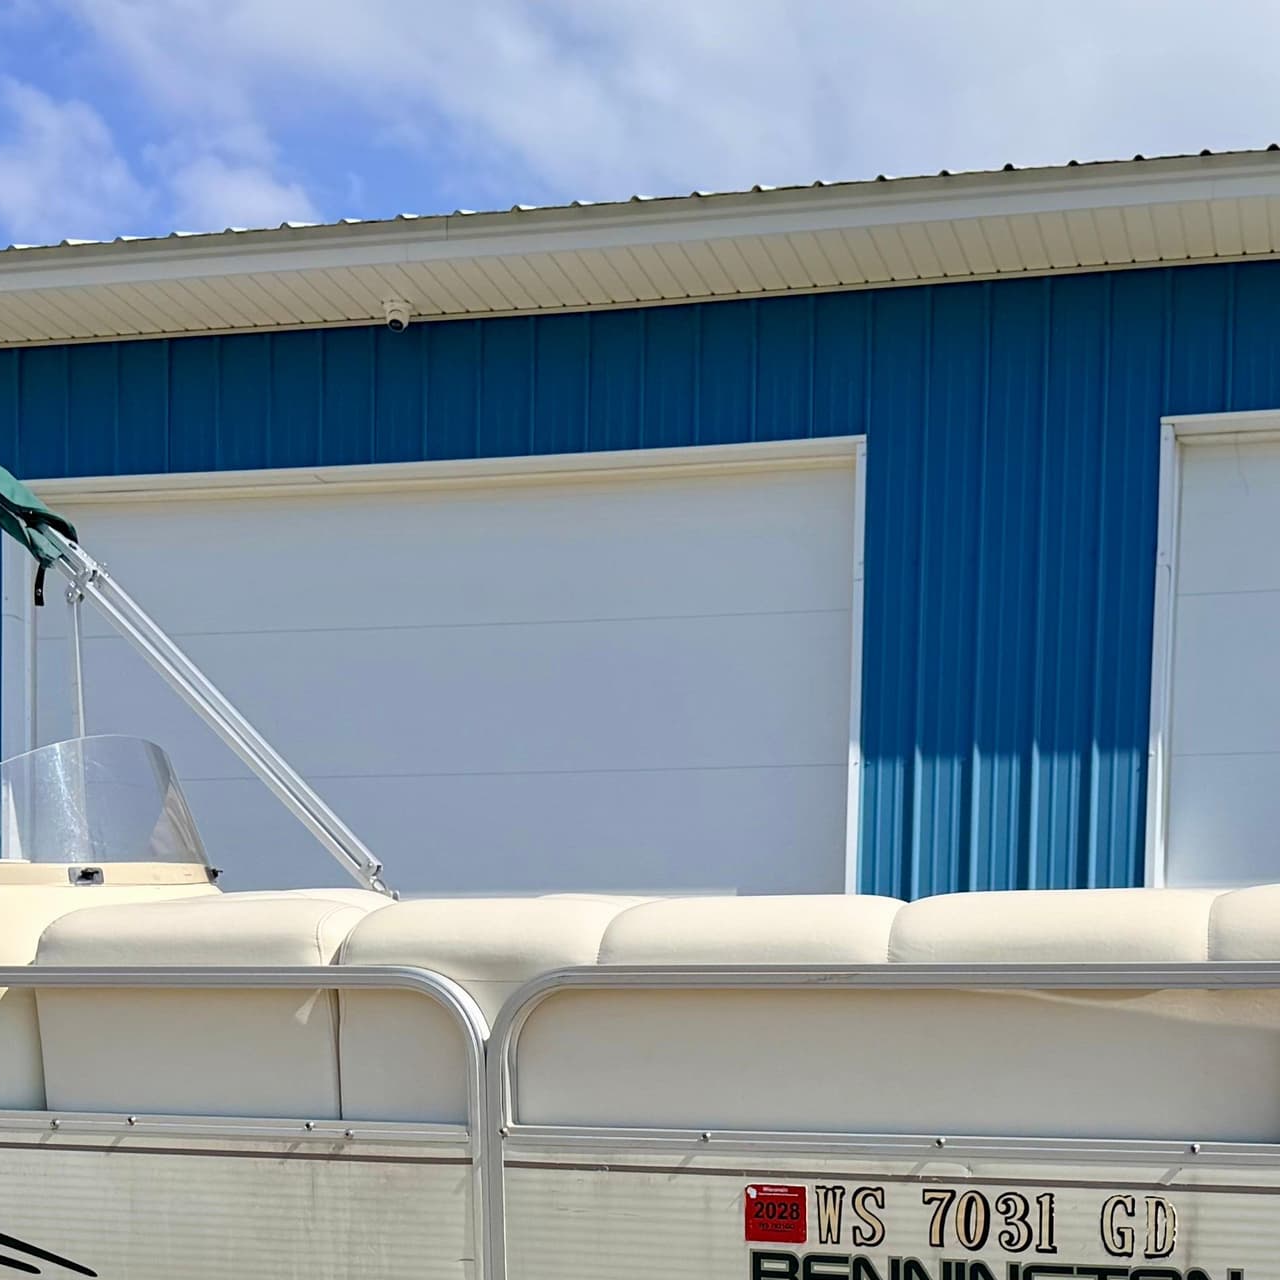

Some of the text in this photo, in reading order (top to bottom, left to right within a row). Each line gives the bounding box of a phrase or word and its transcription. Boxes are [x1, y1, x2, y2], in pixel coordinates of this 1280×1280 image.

[754, 1201, 800, 1220] 2028
[815, 1185, 1178, 1259] WS 7031 GD
